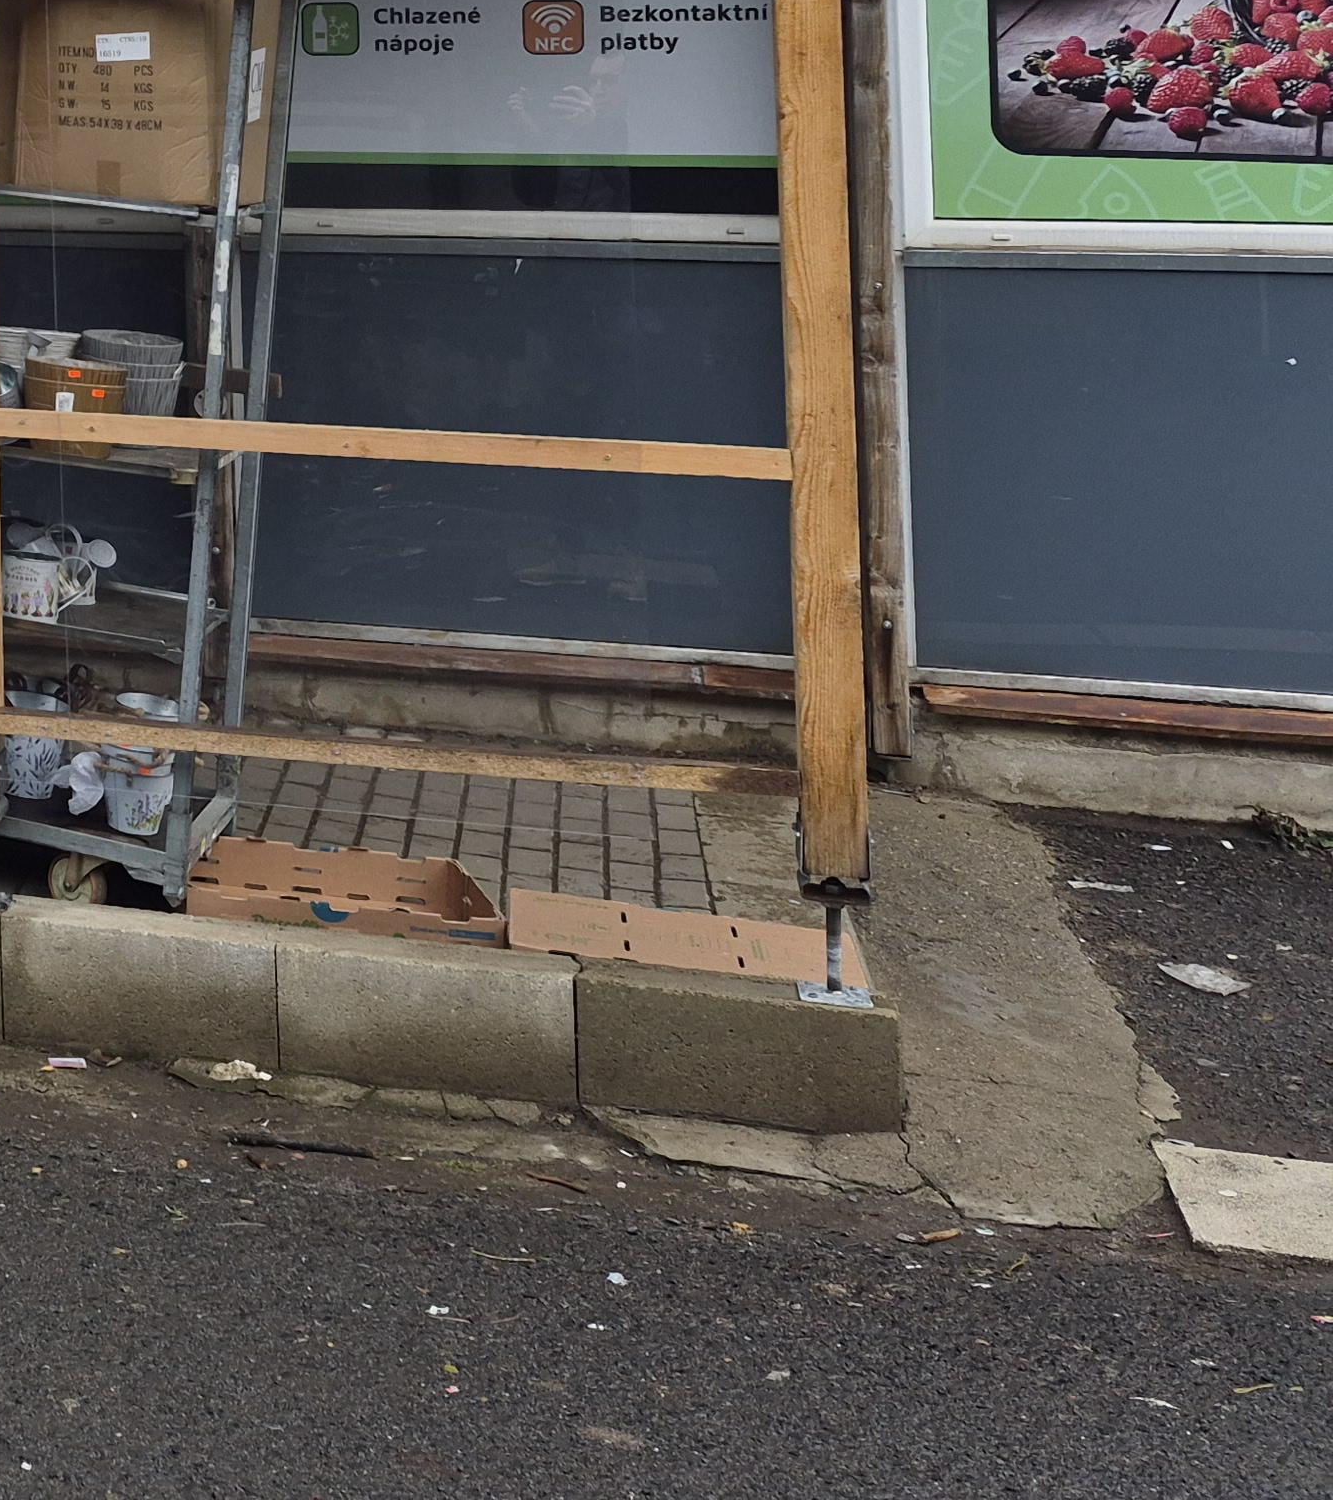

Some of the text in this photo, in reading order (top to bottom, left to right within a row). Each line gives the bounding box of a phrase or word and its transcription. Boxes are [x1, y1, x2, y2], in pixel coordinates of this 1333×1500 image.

[373, 6, 481, 27] Chlazené
[599, 3, 768, 24] Bezkontaktní
[374, 31, 455, 56] nápoje
[534, 36, 574, 52] NFC
[600, 30, 679, 54] platby
[92, 64, 113, 77] 480
[133, 65, 154, 77] PCS
[133, 83, 154, 94] KGS
[133, 100, 154, 111] KGS
